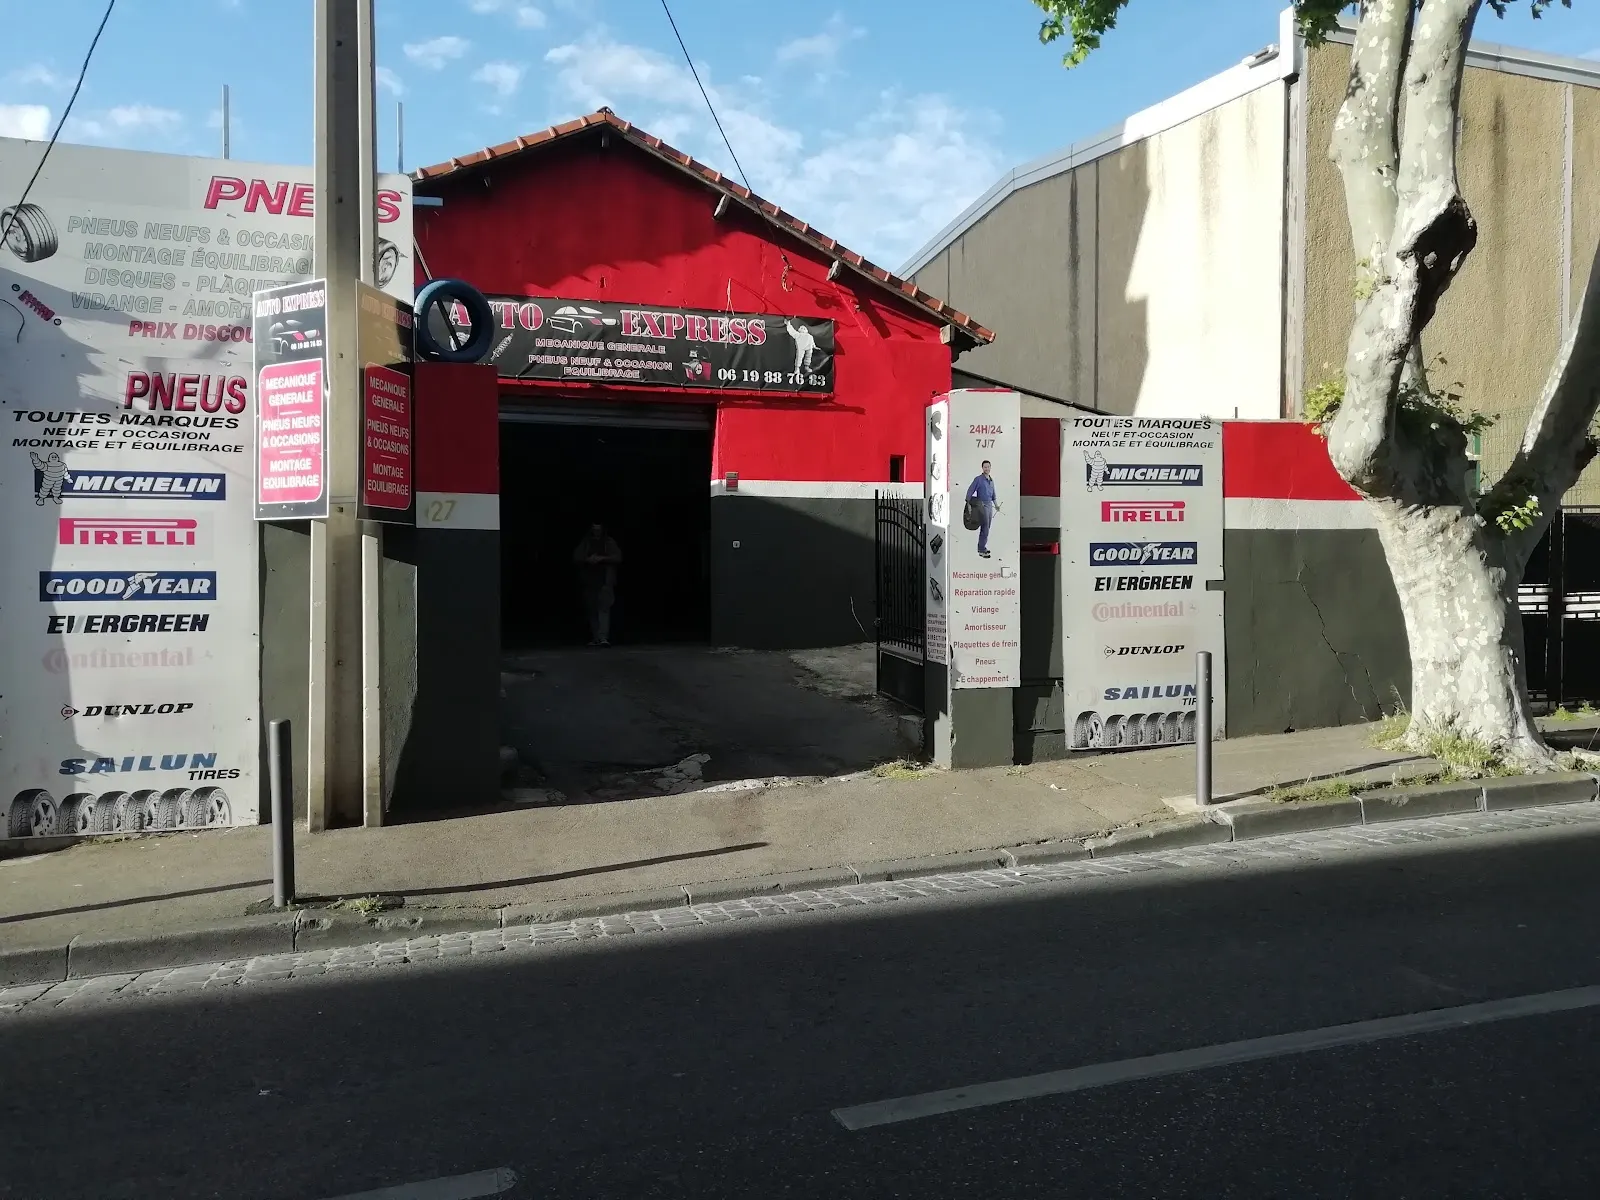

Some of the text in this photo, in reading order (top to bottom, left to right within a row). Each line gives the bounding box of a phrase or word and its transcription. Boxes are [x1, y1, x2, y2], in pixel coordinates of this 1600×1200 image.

[204, 175, 402, 224] PNES
[67, 216, 138, 238] PNEUS
[144, 222, 211, 244] NEUFS
[217, 228, 230, 245] &
[83, 242, 186, 266] MONTAGE
[84, 267, 176, 290] DISQUES
[71, 292, 163, 314] VIDANGE
[256, 297, 281, 318] AUTO
[128, 320, 178, 340] PRIX
[449, 299, 768, 346] ATO EXPRESS
[535, 338, 666, 354] MECANIQUE GENERALE
[528, 354, 672, 371] PNEUS NEUF & OCCASION
[563, 366, 640, 379] EQUILIBRAGE
[717, 368, 826, 387] 06 19 88 76 83
[265, 373, 316, 390] MECANIQUE
[369, 376, 407, 398] MECANIQUE
[124, 371, 248, 415] PNEUS
[268, 390, 314, 406] GENERALE
[371, 394, 405, 414] GENERALE
[12, 410, 240, 430] TOUTES MARQUES
[263, 415, 321, 432] PNEUS NEUFS
[1073, 418, 1212, 430] TOUTES MARQUES
[43, 427, 211, 441] NEUF ET OCCASION
[367, 418, 410, 440] PNEUS NEUFS
[969, 424, 1002, 435] 24H/24
[1139, 431, 1194, 439] OCCASION
[12, 438, 244, 453] MONTAGE ET ÉQUILIBRAGE
[263, 433, 320, 448] & OCCASIONS
[367, 437, 410, 456] & OCCASIONS
[975, 439, 996, 449] 7J/7
[1072, 440, 1126, 448] MONTAGE
[1145, 440, 1214, 449] ÉQUILIBRAGE
[270, 458, 312, 472] MONTAGE
[372, 463, 404, 479] MONTAGE
[263, 474, 320, 490] EQUILIBRAGE
[1109, 468, 1200, 481] MICHELIN
[72, 475, 221, 493] MICHELIN
[367, 481, 409, 497] EQUILIBRAGE
[431, 500, 457, 521] 27
[1101, 501, 1186, 522] PIRELLI
[59, 517, 198, 546] PIRELLI
[952, 571, 987, 580] Mécanique
[1094, 575, 1194, 592] EVERGREEN
[954, 588, 1016, 598] Réparation rapide
[971, 606, 999, 615] Vidange
[1092, 601, 1184, 622] Continental
[46, 613, 210, 634] EVERGREEN
[964, 623, 1007, 632] Amortisseur
[953, 641, 990, 650] Plaquettes
[991, 640, 1000, 648] de
[1002, 640, 1018, 648] frein
[1117, 644, 1185, 656] DUNLOP
[975, 658, 996, 666] Pneus
[82, 702, 194, 717] DUNLOP
[58, 752, 218, 775] SAILUN
[187, 768, 241, 781] TIRES
